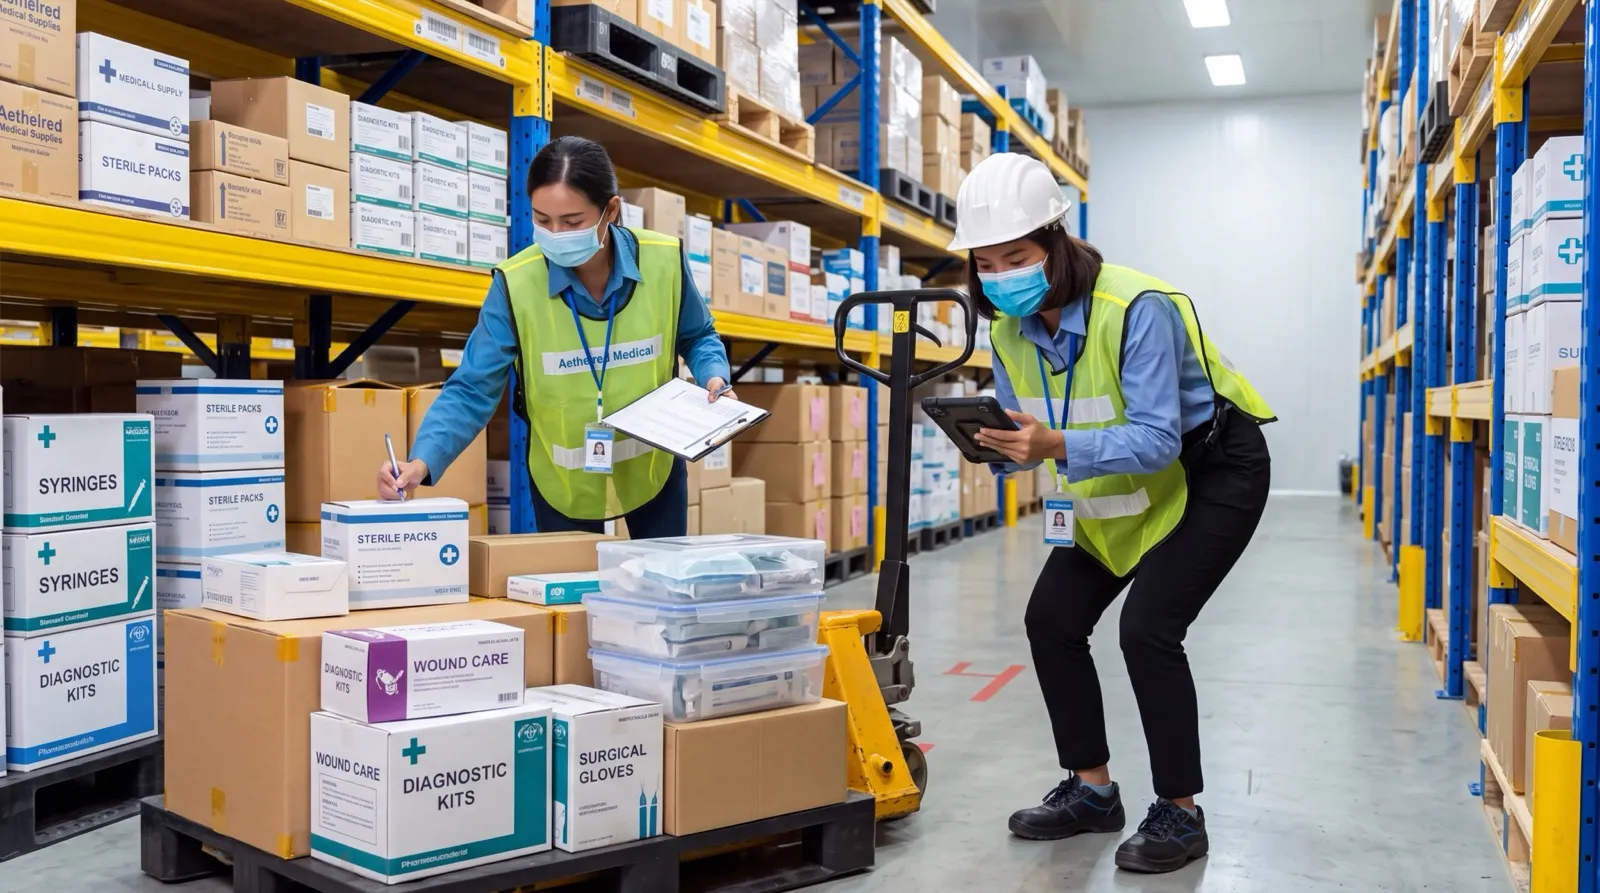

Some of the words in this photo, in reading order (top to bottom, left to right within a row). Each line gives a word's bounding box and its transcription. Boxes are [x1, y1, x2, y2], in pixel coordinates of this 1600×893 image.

[0, 4, 26, 20] edical
[28, 13, 61, 32] Supplies
[119, 73, 156, 90] MEDICALL
[157, 84, 183, 97] SUPPLY
[30, 129, 62, 144] Supplies
[102, 155, 145, 175] STERILE
[148, 164, 181, 182] PACKS
[613, 345, 654, 361] Medical
[206, 404, 237, 413] STERILE
[238, 404, 262, 413] PACKS
[39, 474, 118, 495] SYRINGES
[208, 494, 239, 506] STERILE
[240, 492, 264, 503] PACKS
[357, 533, 401, 544] STERILE
[403, 531, 438, 542] PACKS
[39, 567, 119, 594] SYRINGES
[324, 662, 363, 682] DIAGNOSTIC
[413, 656, 468, 673] WOUND
[471, 652, 509, 668] CARE
[40, 658, 120, 689] DIAGNOSTIC
[67, 683, 96, 703] KITS
[335, 680, 350, 694] KITS
[579, 743, 647, 766] SURGICAL
[315, 751, 351, 773] WOUND
[353, 762, 380, 782] CARE
[579, 763, 634, 784] GLOVES
[403, 762, 507, 794] DIAGNOSTIC
[437, 790, 475, 811] KITS
